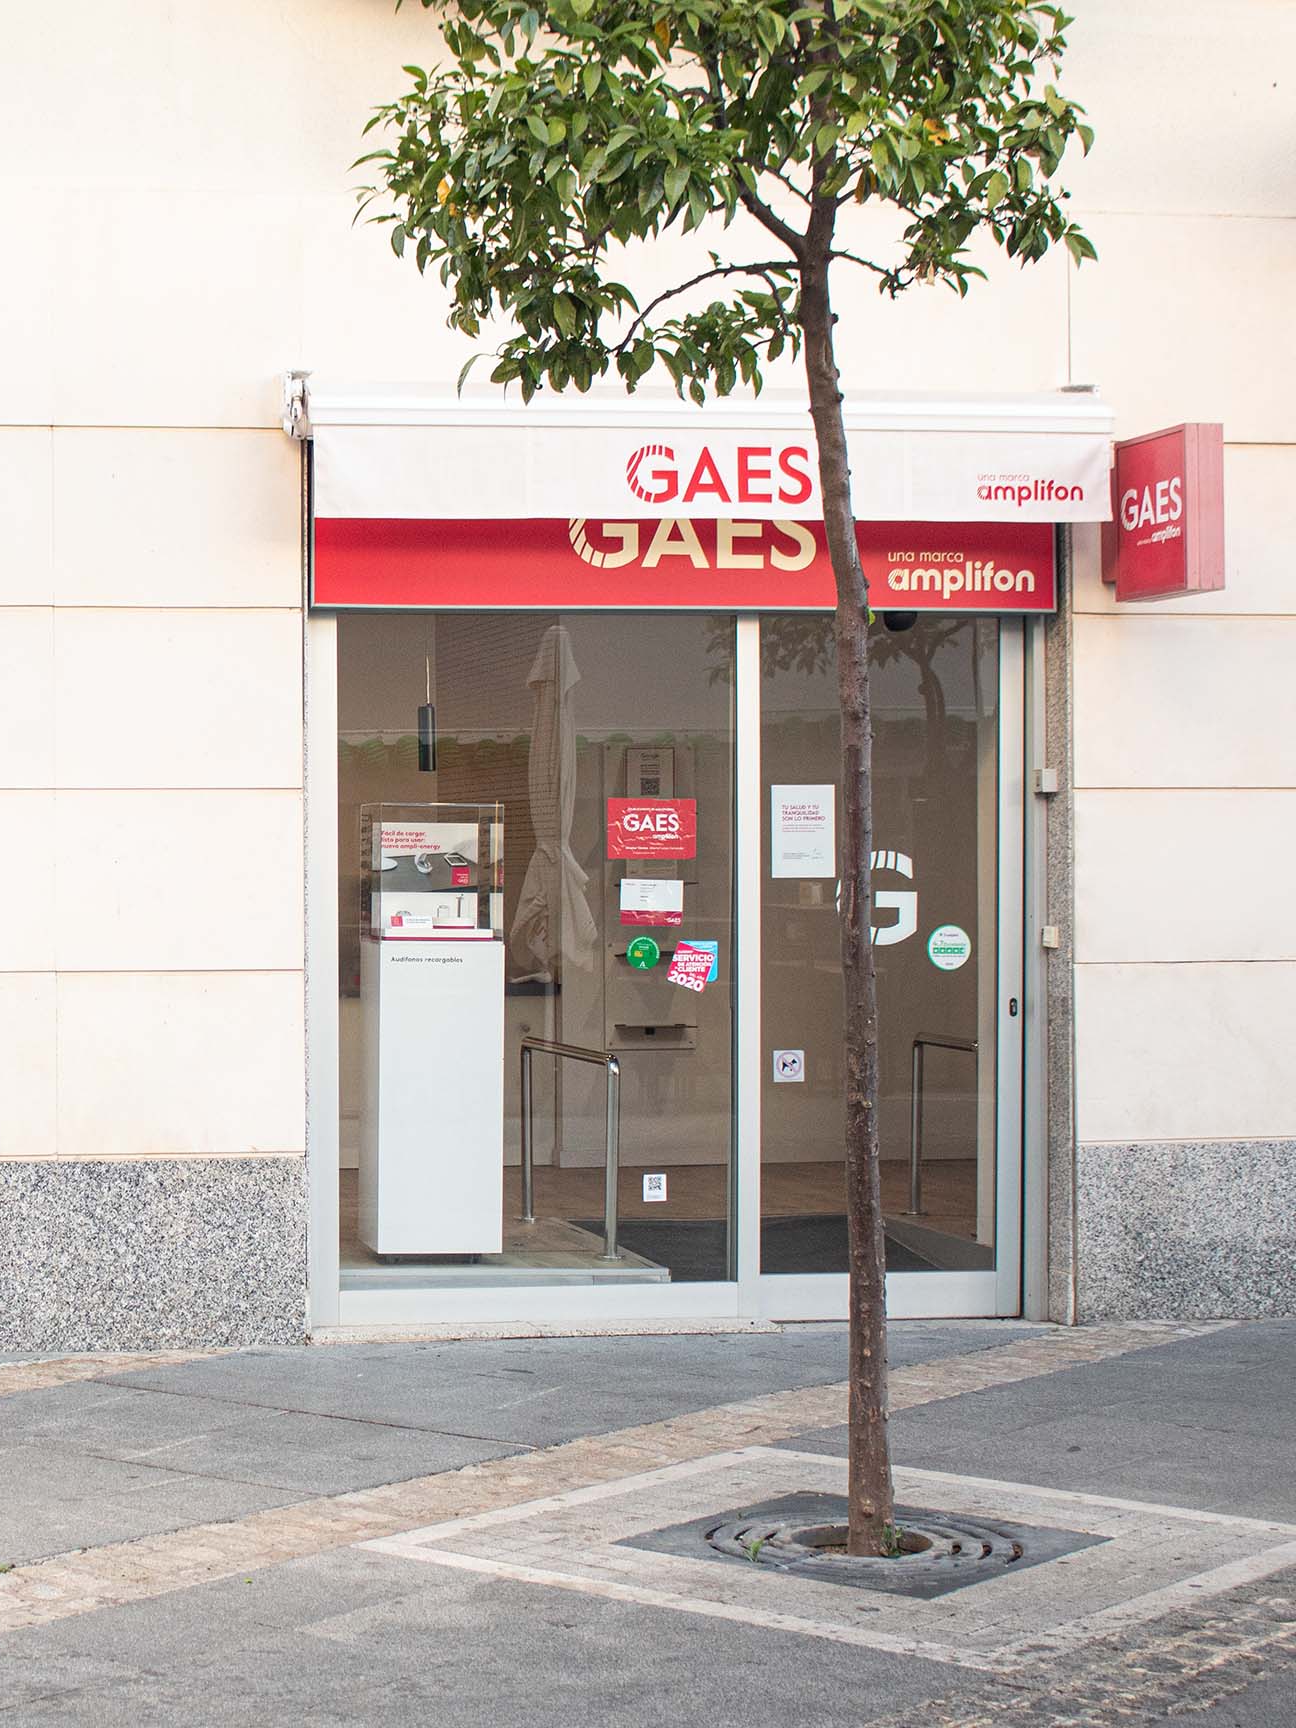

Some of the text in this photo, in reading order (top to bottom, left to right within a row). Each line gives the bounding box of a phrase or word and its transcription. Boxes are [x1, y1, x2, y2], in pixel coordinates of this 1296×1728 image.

[626, 444, 813, 504] GAES
[977, 474, 1030, 482] una marca
[976, 480, 1084, 506] amplifon
[1121, 477, 1182, 531] GAES
[568, 518, 817, 571] GAES
[888, 551, 963, 563] una marca
[888, 561, 1035, 600] amplifon
[623, 813, 680, 832] GAES
[672, 953, 714, 962] SERVICIO
[667, 970, 705, 992] 2020
